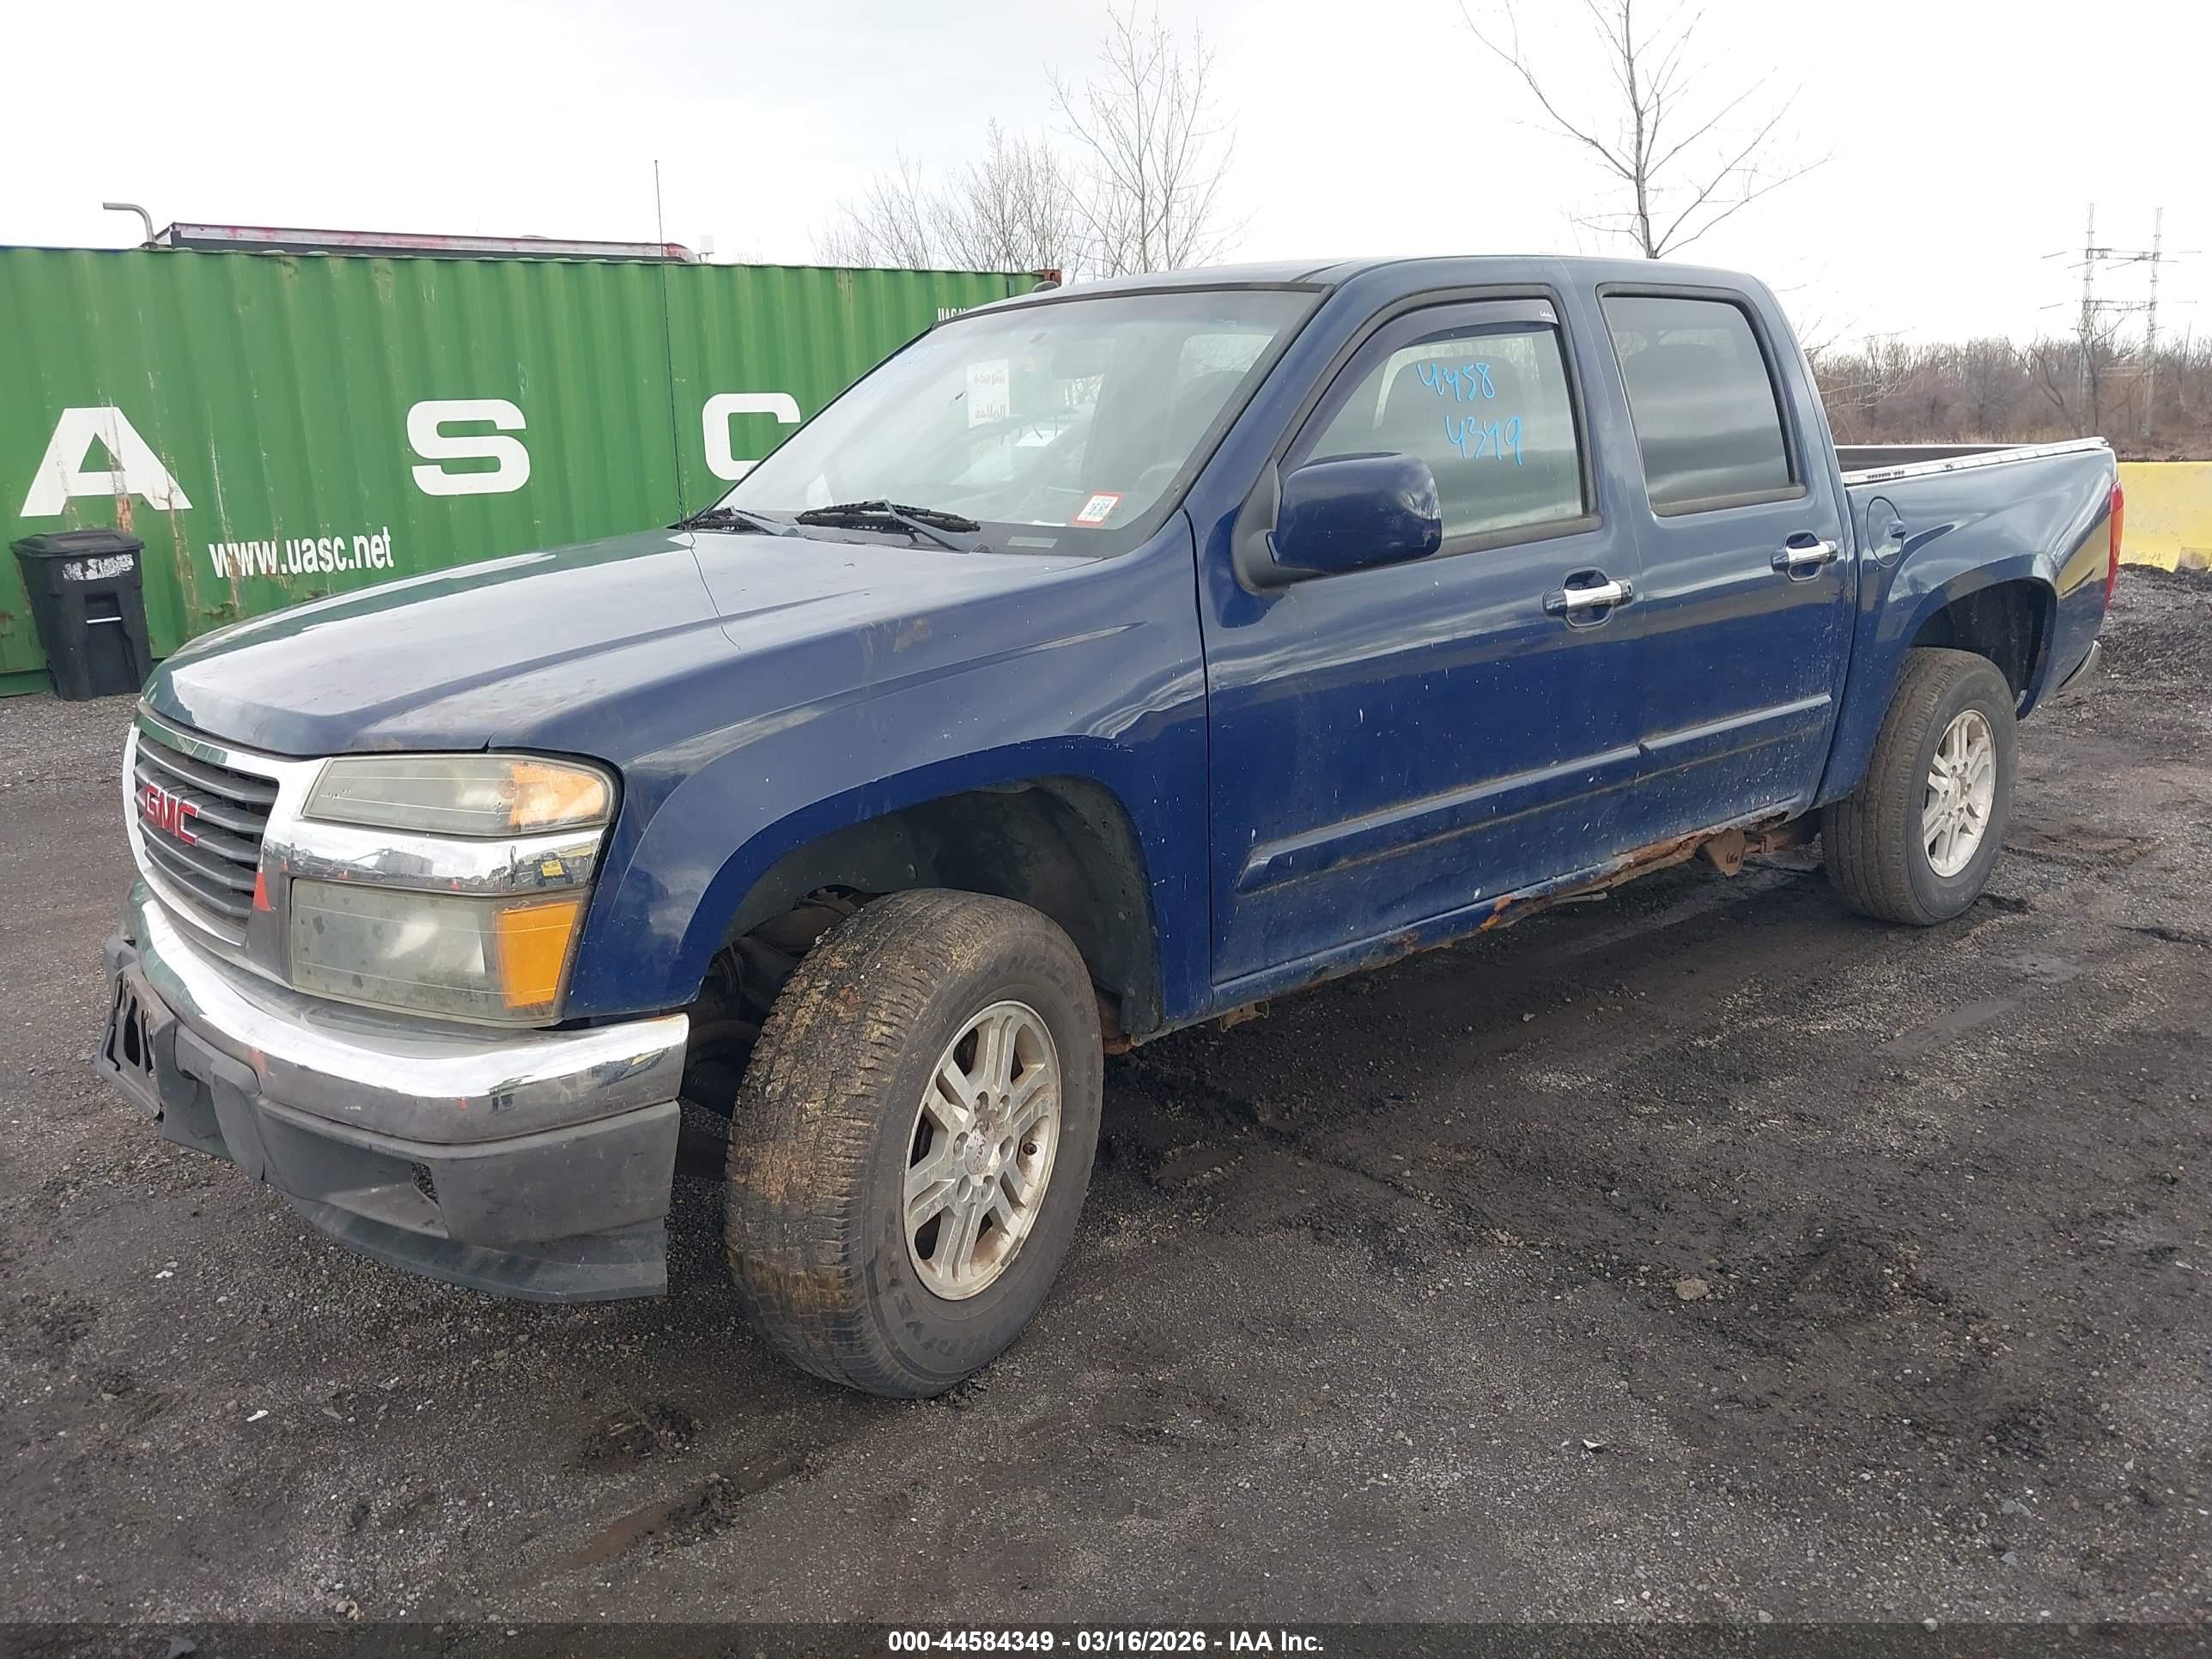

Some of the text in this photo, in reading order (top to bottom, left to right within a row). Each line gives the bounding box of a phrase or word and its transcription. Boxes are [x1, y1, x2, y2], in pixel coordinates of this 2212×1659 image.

[1416, 362, 1496, 402] 4458
[21, 392, 801, 517] A S C
[1444, 413, 1523, 467] 4349
[208, 526, 395, 578] www.uasc.net
[144, 781, 200, 848] GMC
